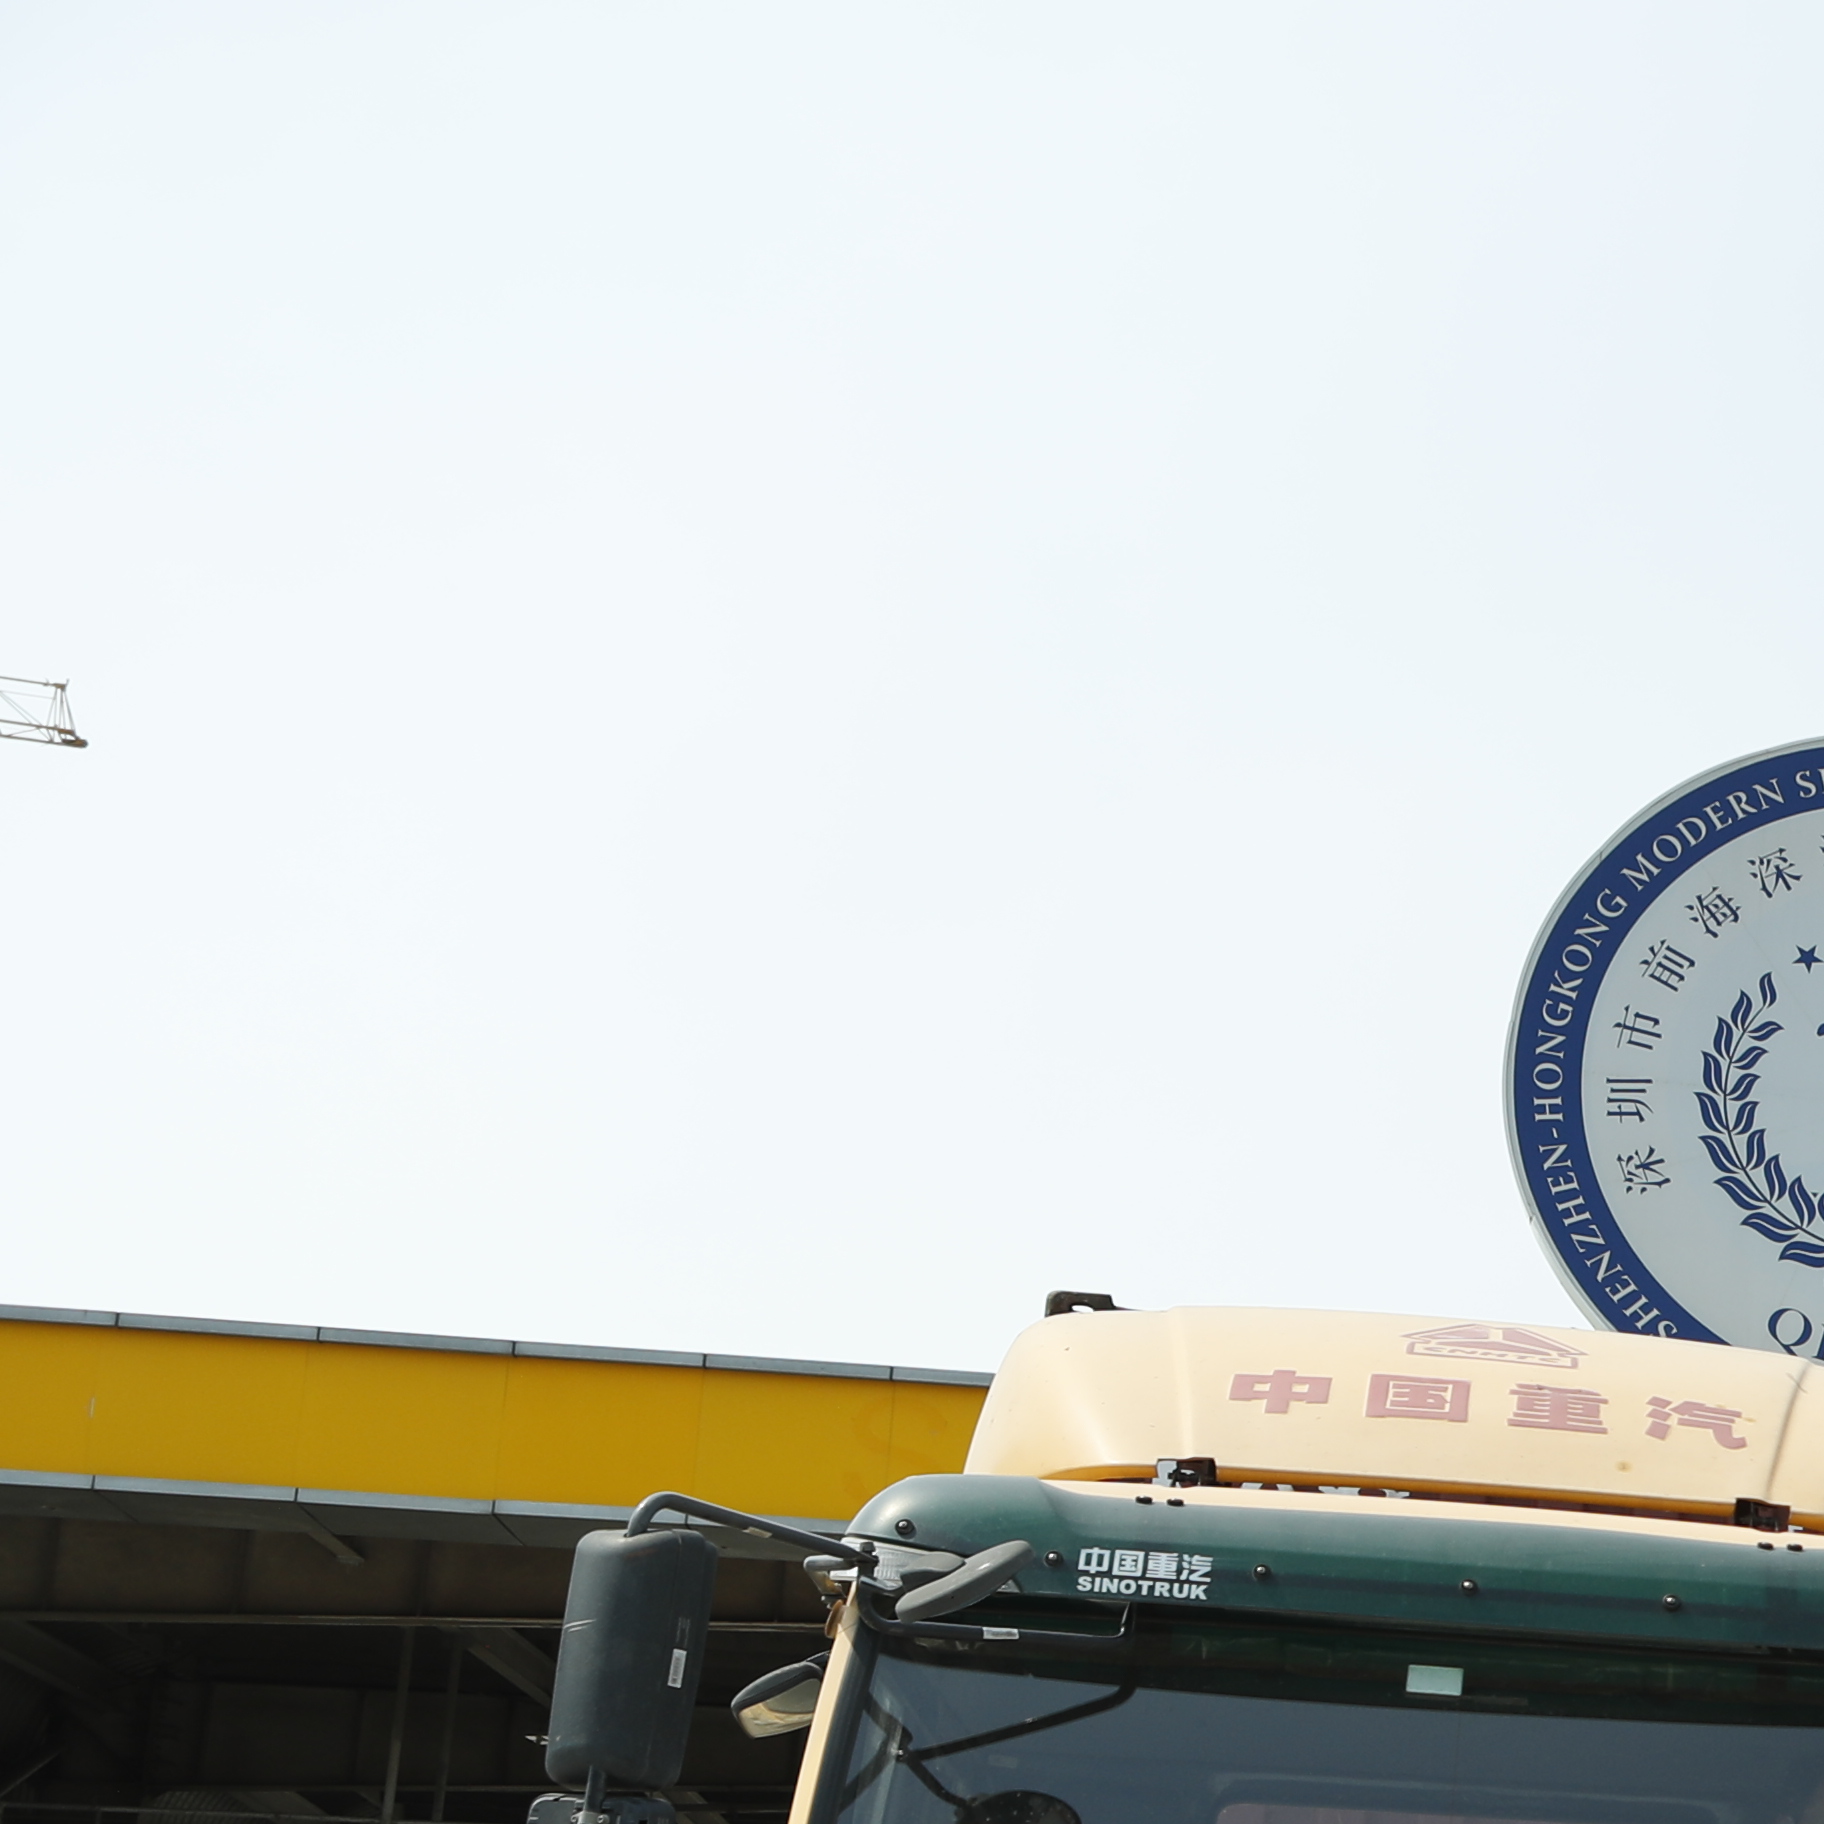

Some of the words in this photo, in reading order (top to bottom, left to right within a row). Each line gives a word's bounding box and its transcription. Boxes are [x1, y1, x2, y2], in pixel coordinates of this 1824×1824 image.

[1621, 774, 1786, 893] MODERN
[1228, 1369, 1748, 1450] 中国重汽
[1076, 1575, 1209, 1600] SINOTRUK
[1077, 1546, 1214, 1583] 中国重汽
